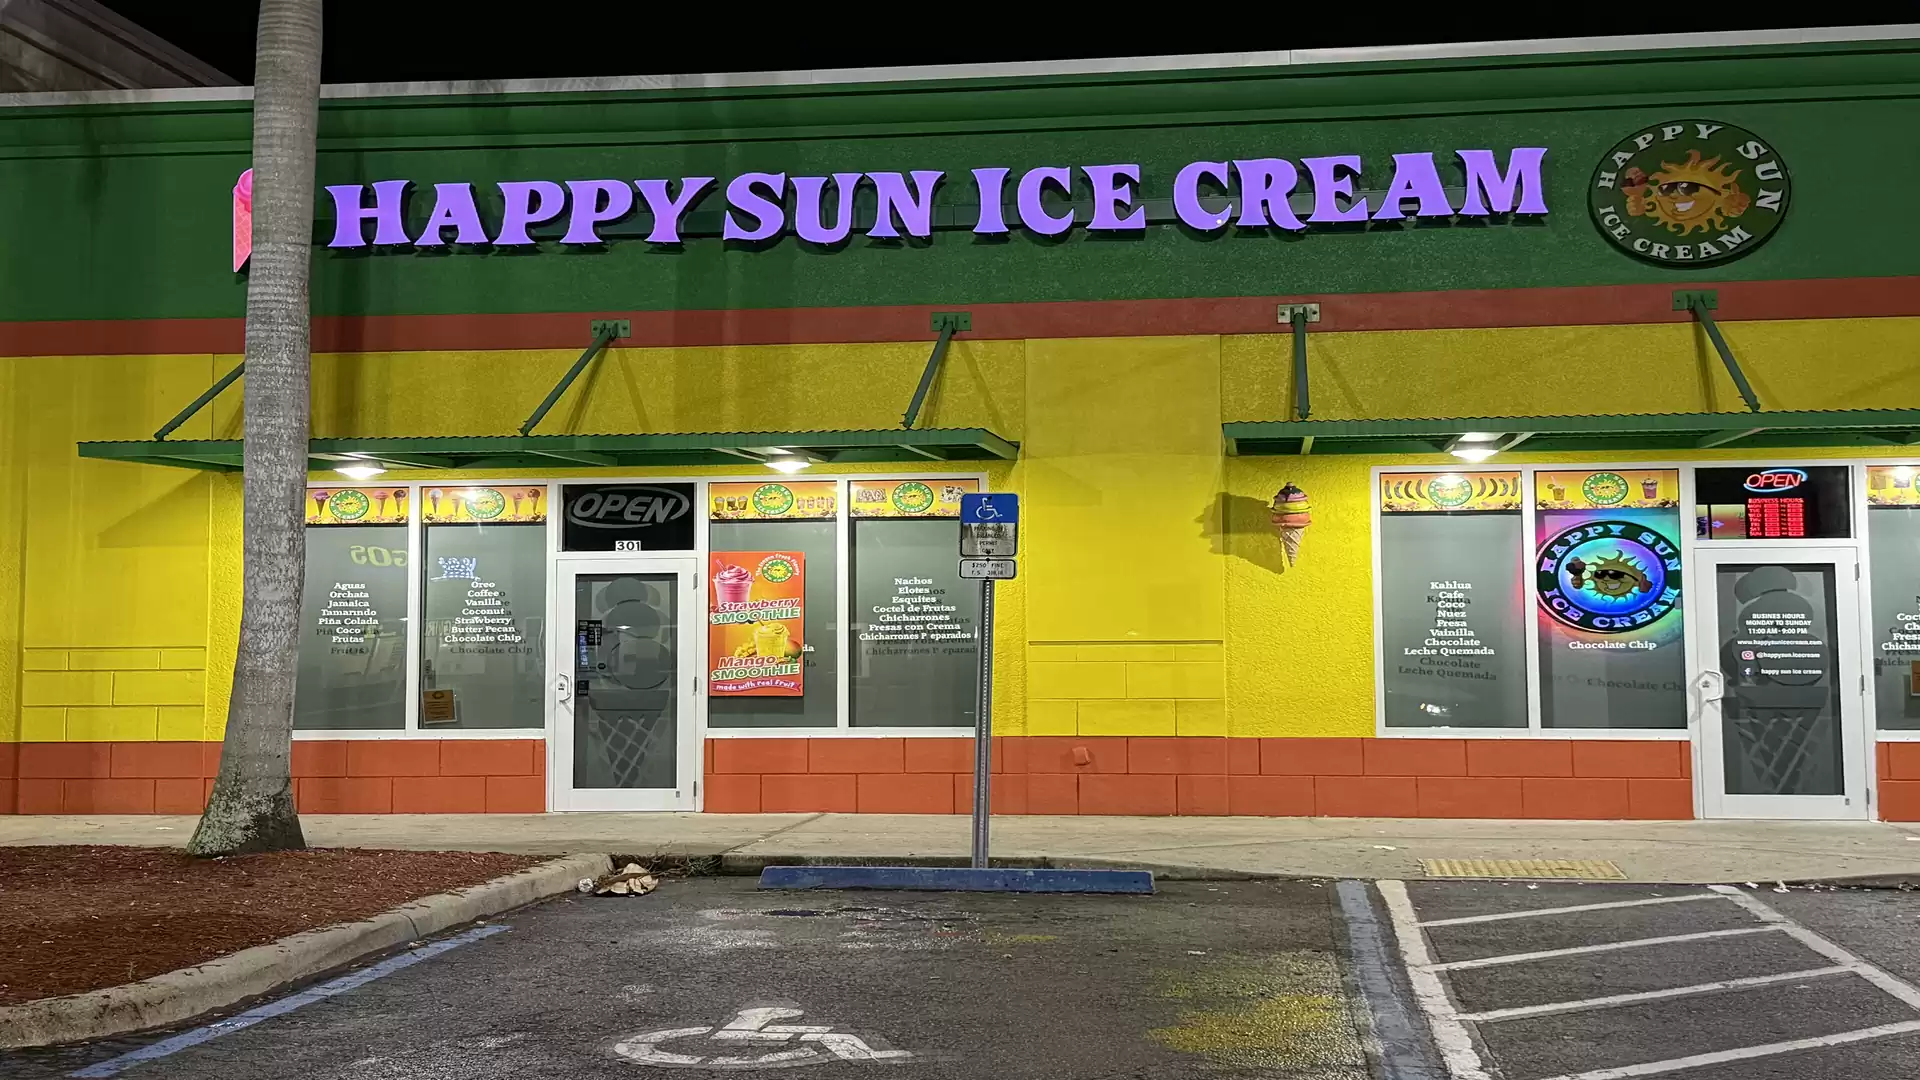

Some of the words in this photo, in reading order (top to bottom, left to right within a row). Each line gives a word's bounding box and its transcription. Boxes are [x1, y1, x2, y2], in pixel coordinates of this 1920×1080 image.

[1597, 124, 1724, 190] HAPPY
[1736, 140, 1784, 213] SUN
[325, 176, 715, 247] HAPPY
[723, 170, 946, 244] SUN
[971, 164, 1146, 235] ICE
[1173, 148, 1549, 232] CREAM
[1598, 206, 1631, 241] ICE
[1632, 225, 1752, 260] CREAM
[1746, 474, 1801, 488] OPEN
[572, 493, 678, 523] OPEN
[616, 541, 640, 551] 301
[1540, 524, 1626, 574] HAPPY
[1638, 532, 1681, 571] SUN
[894, 577, 932, 585] Nachos
[1430, 581, 1472, 589] Kahlua
[334, 582, 366, 590] Aguas
[898, 586, 930, 594] Elotes
[1439, 590, 1464, 598] Cafe
[327, 600, 370, 609] Jamaica
[465, 598, 501, 606] Vanilla
[892, 596, 936, 604] Esquites
[1438, 600, 1465, 608] Coco
[718, 598, 800, 612] Strawberry
[1544, 588, 1584, 621] ICE
[1592, 586, 1680, 628] CREAM
[462, 608, 505, 616] Coconut
[710, 607, 800, 624] SMOOTHIE
[344, 617, 379, 625] Colada
[455, 616, 511, 625] Strawberry
[879, 614, 950, 622] Chicharrones
[1429, 628, 1475, 636] Vainilla
[444, 634, 495, 643] Chocolate
[497, 634, 521, 643] Chip
[1424, 638, 1480, 646] Chocolate
[1568, 640, 1626, 650] Chocolate
[1628, 640, 1656, 650] Chip
[1404, 647, 1437, 655] Leche
[1440, 647, 1495, 656] Quemada
[718, 656, 777, 669] Mango
[711, 663, 800, 680] SMOOTHIE
[738, 681, 756, 689] with
